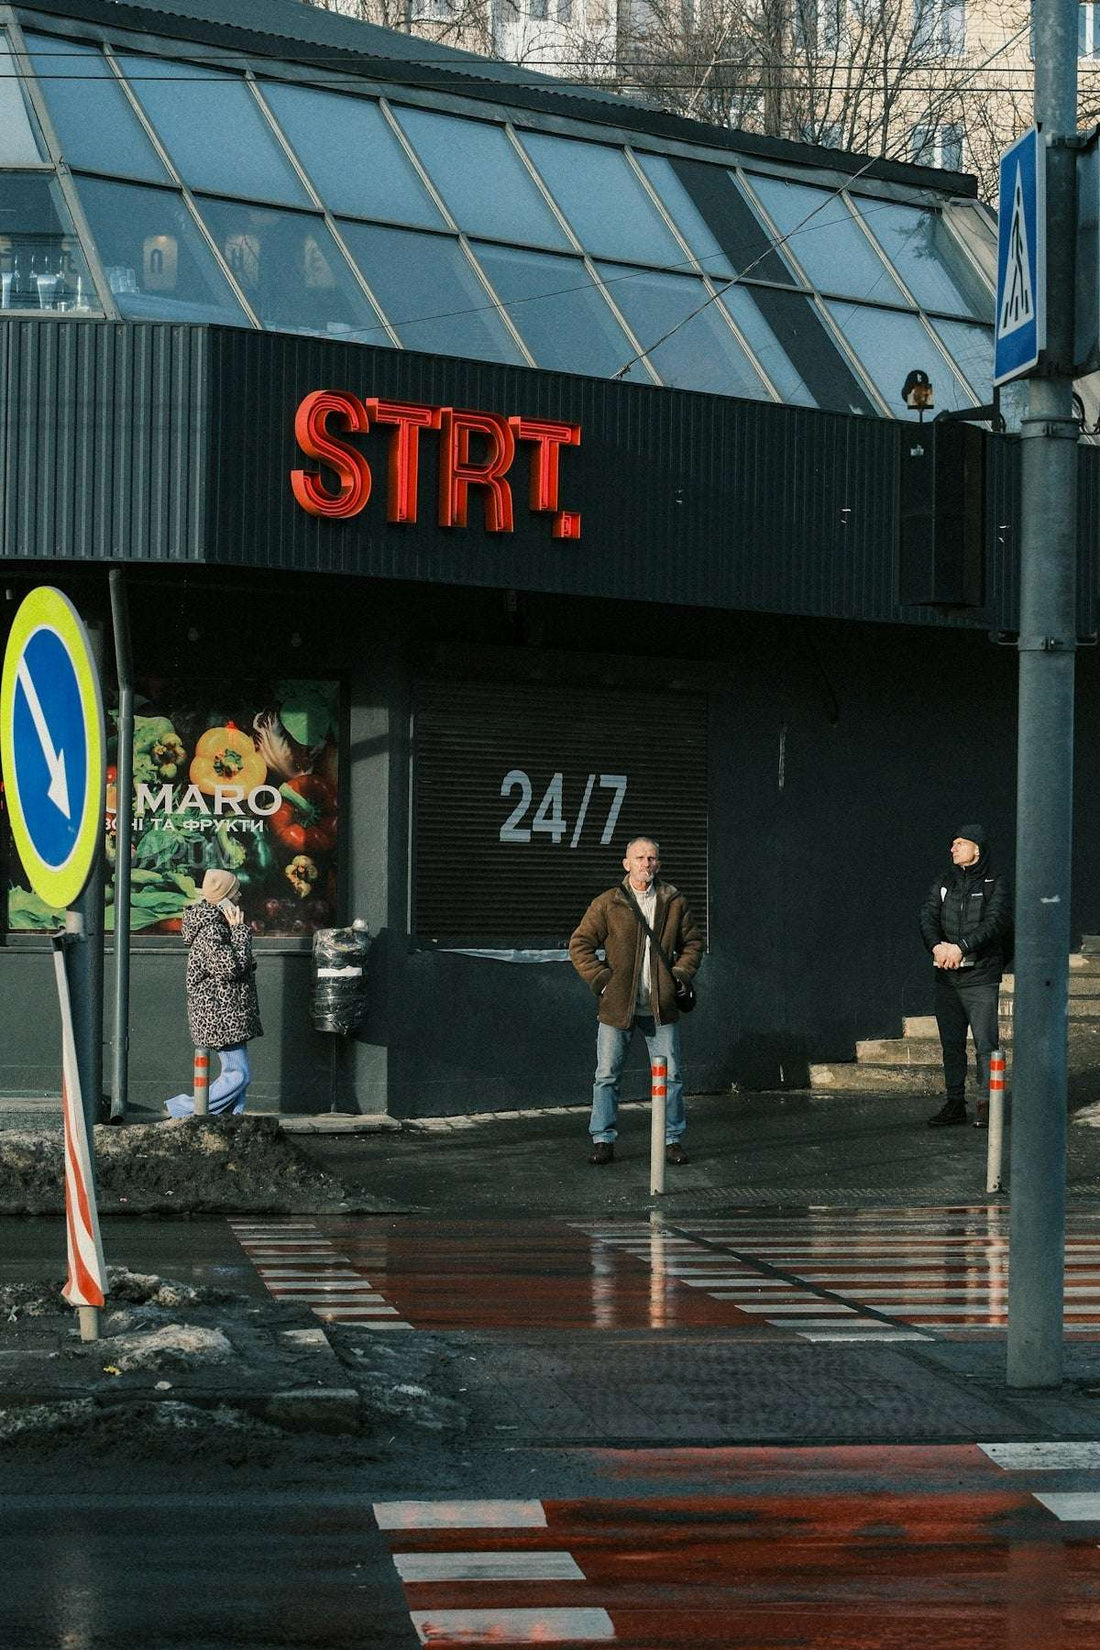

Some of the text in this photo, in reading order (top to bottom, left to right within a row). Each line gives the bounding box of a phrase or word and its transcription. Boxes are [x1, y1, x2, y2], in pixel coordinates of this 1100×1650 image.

[150, 818, 176, 832] ТА
[183, 818, 264, 833] ФРУКТИ
[499, 769, 628, 848] 24/7
